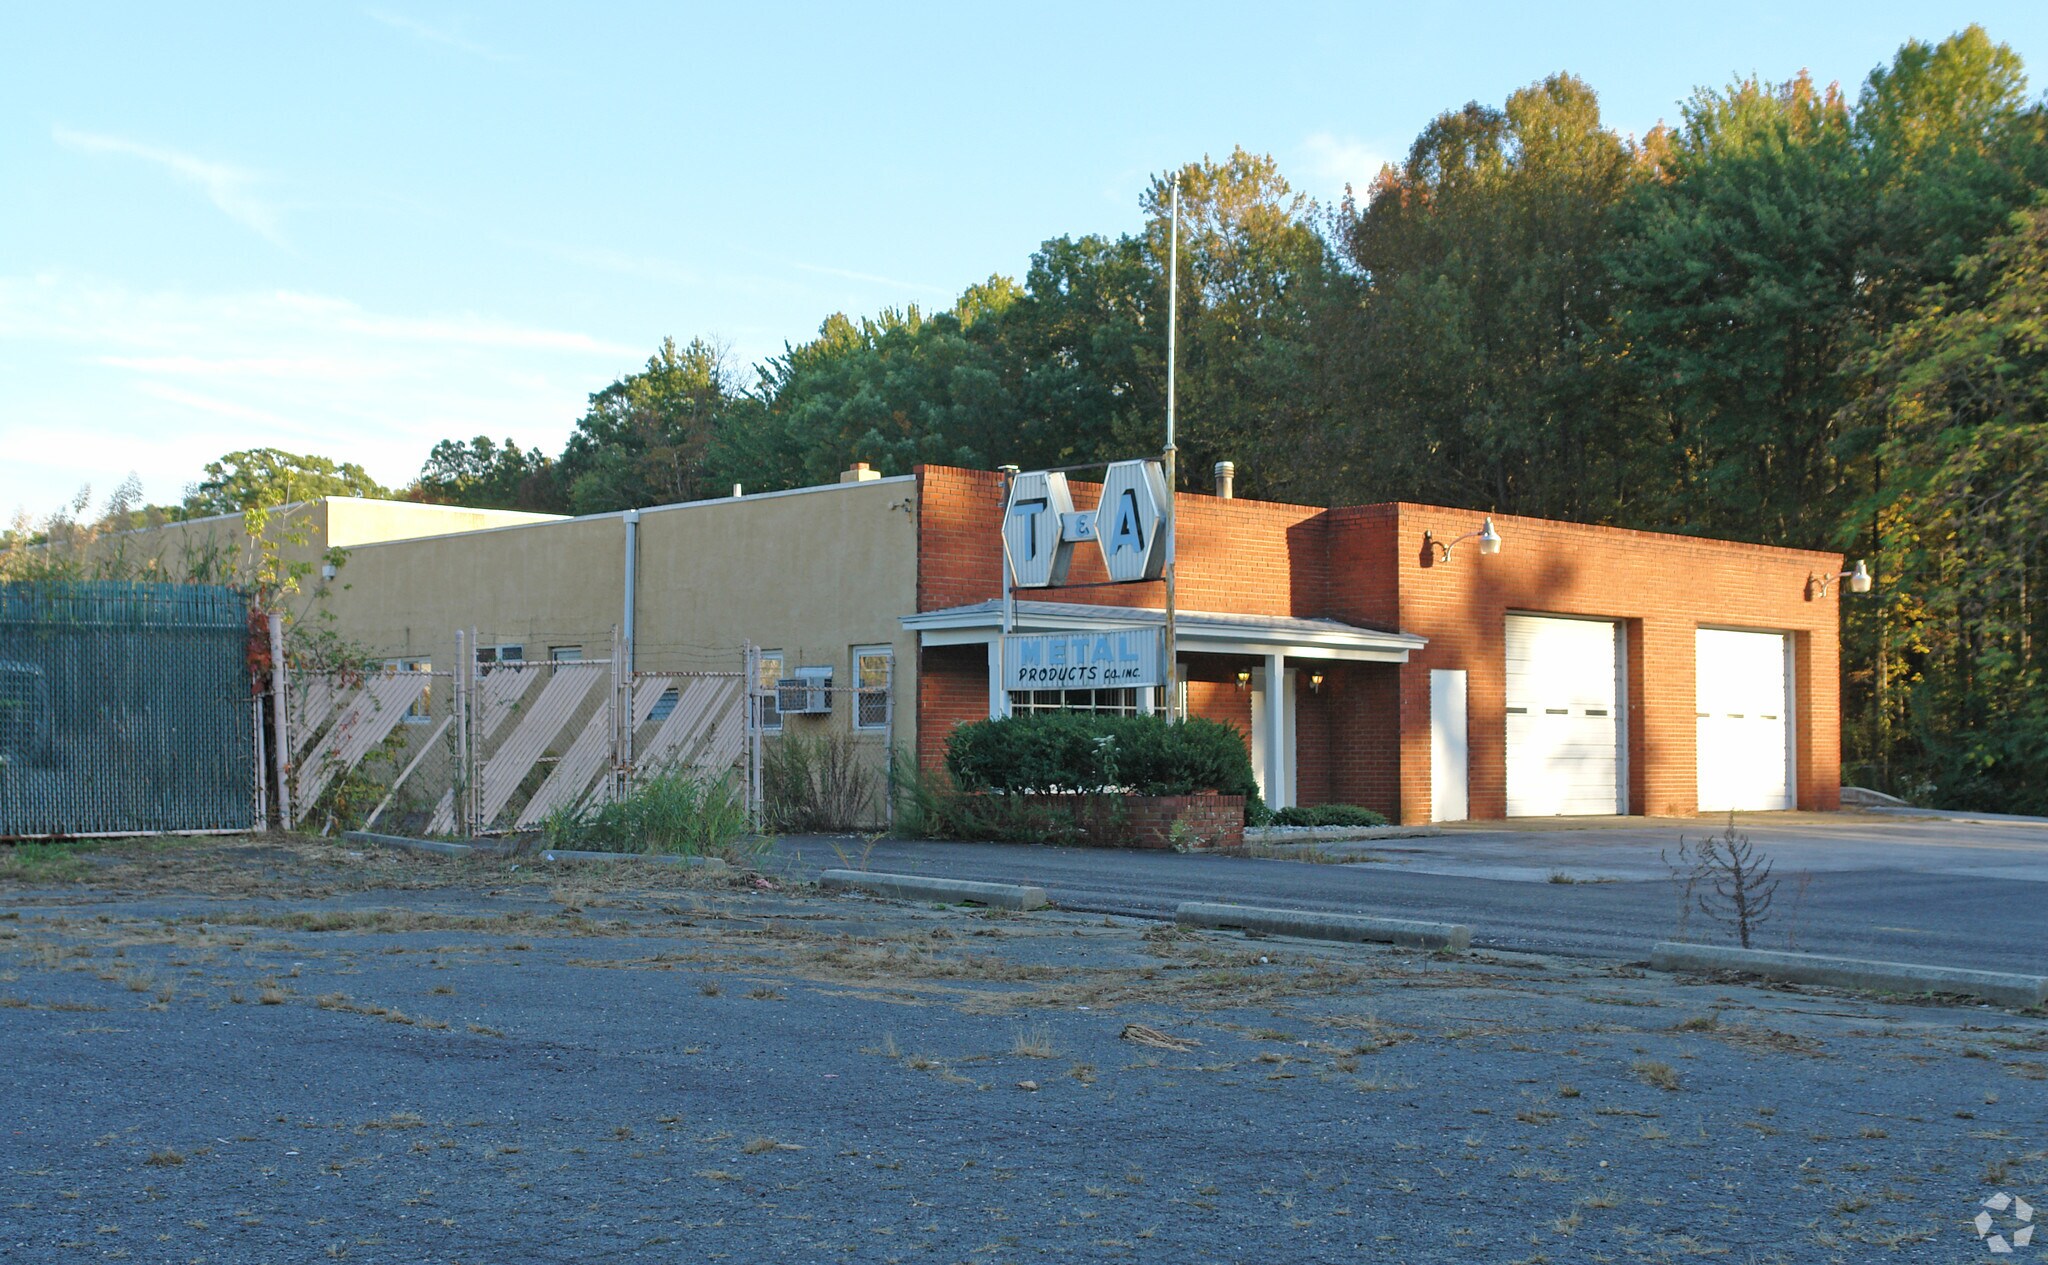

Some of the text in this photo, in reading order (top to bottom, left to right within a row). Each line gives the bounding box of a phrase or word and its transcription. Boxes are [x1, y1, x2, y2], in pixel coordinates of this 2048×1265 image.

[1013, 488, 1145, 561] T & A
[1021, 637, 1139, 666] METAL
[1019, 666, 1098, 681] PRODUCTS
